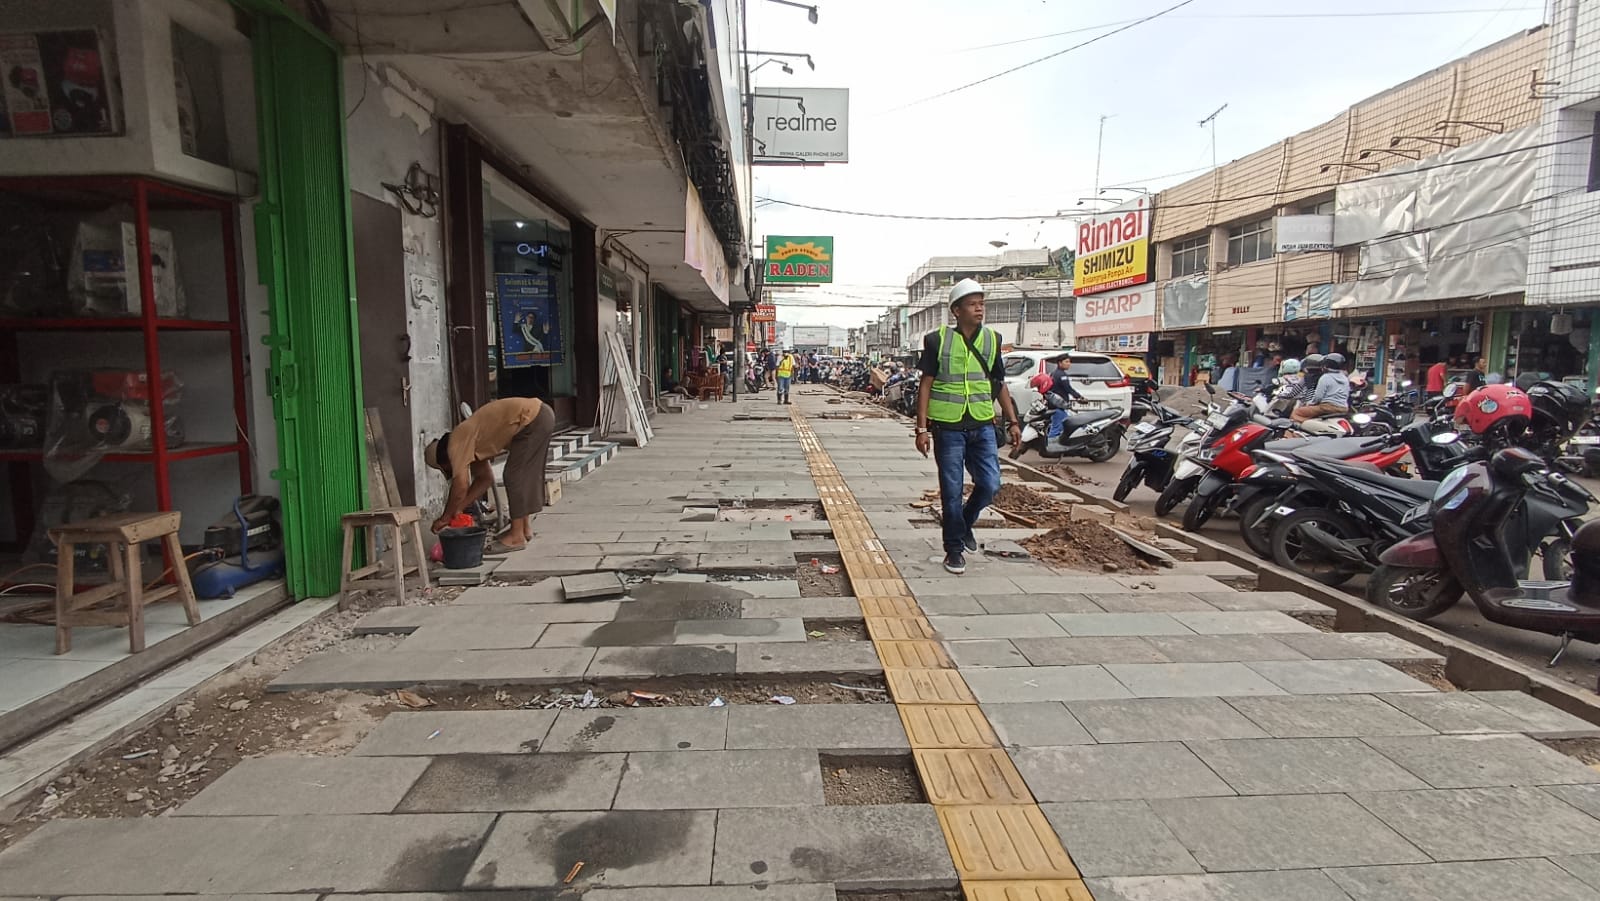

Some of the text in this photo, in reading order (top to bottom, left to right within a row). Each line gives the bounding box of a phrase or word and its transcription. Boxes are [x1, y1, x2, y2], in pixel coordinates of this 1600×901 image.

[767, 114, 837, 131] realme
[1078, 198, 1143, 256] Rinnai
[769, 263, 830, 277] RADEN
[1083, 244, 1135, 275] SHIMIZU
[1107, 269, 1125, 278] Pompa
[1125, 265, 1135, 273] Air
[1085, 292, 1142, 318] SHARP
